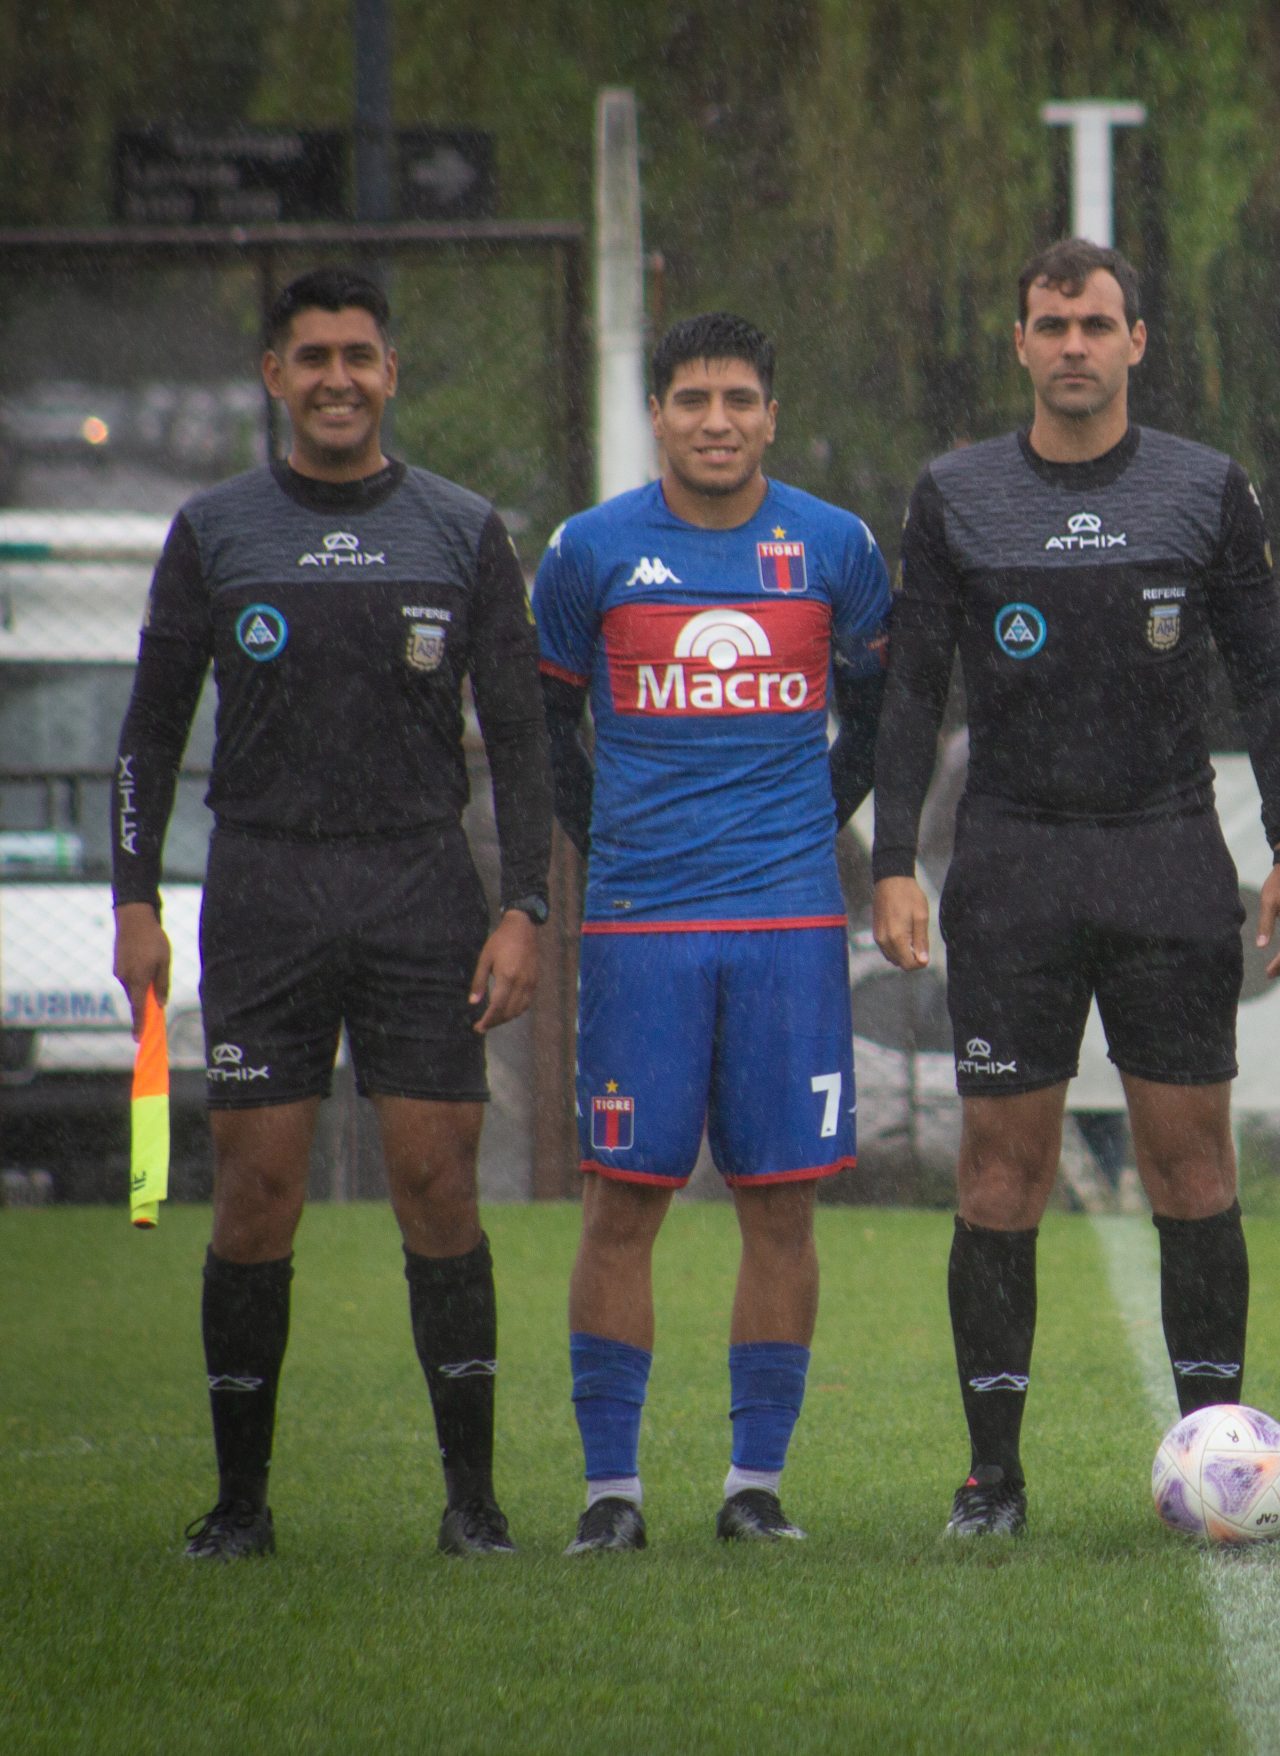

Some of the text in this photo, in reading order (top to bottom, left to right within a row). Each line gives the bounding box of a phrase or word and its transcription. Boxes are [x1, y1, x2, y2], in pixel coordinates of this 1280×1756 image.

[1045, 532, 1126, 550] ATHIX
[762, 545, 800, 557] TIGRE
[299, 552, 386, 565] ATHIX
[1143, 587, 1187, 601] REFEREE
[636, 664, 808, 710] Macro
[119, 754, 137, 854] ATHIX
[957, 1060, 1017, 1074] ATHIX
[594, 1099, 632, 1111] TIGRE
[810, 1072, 842, 1138] 7
[1256, 1513, 1279, 1525] CAP
